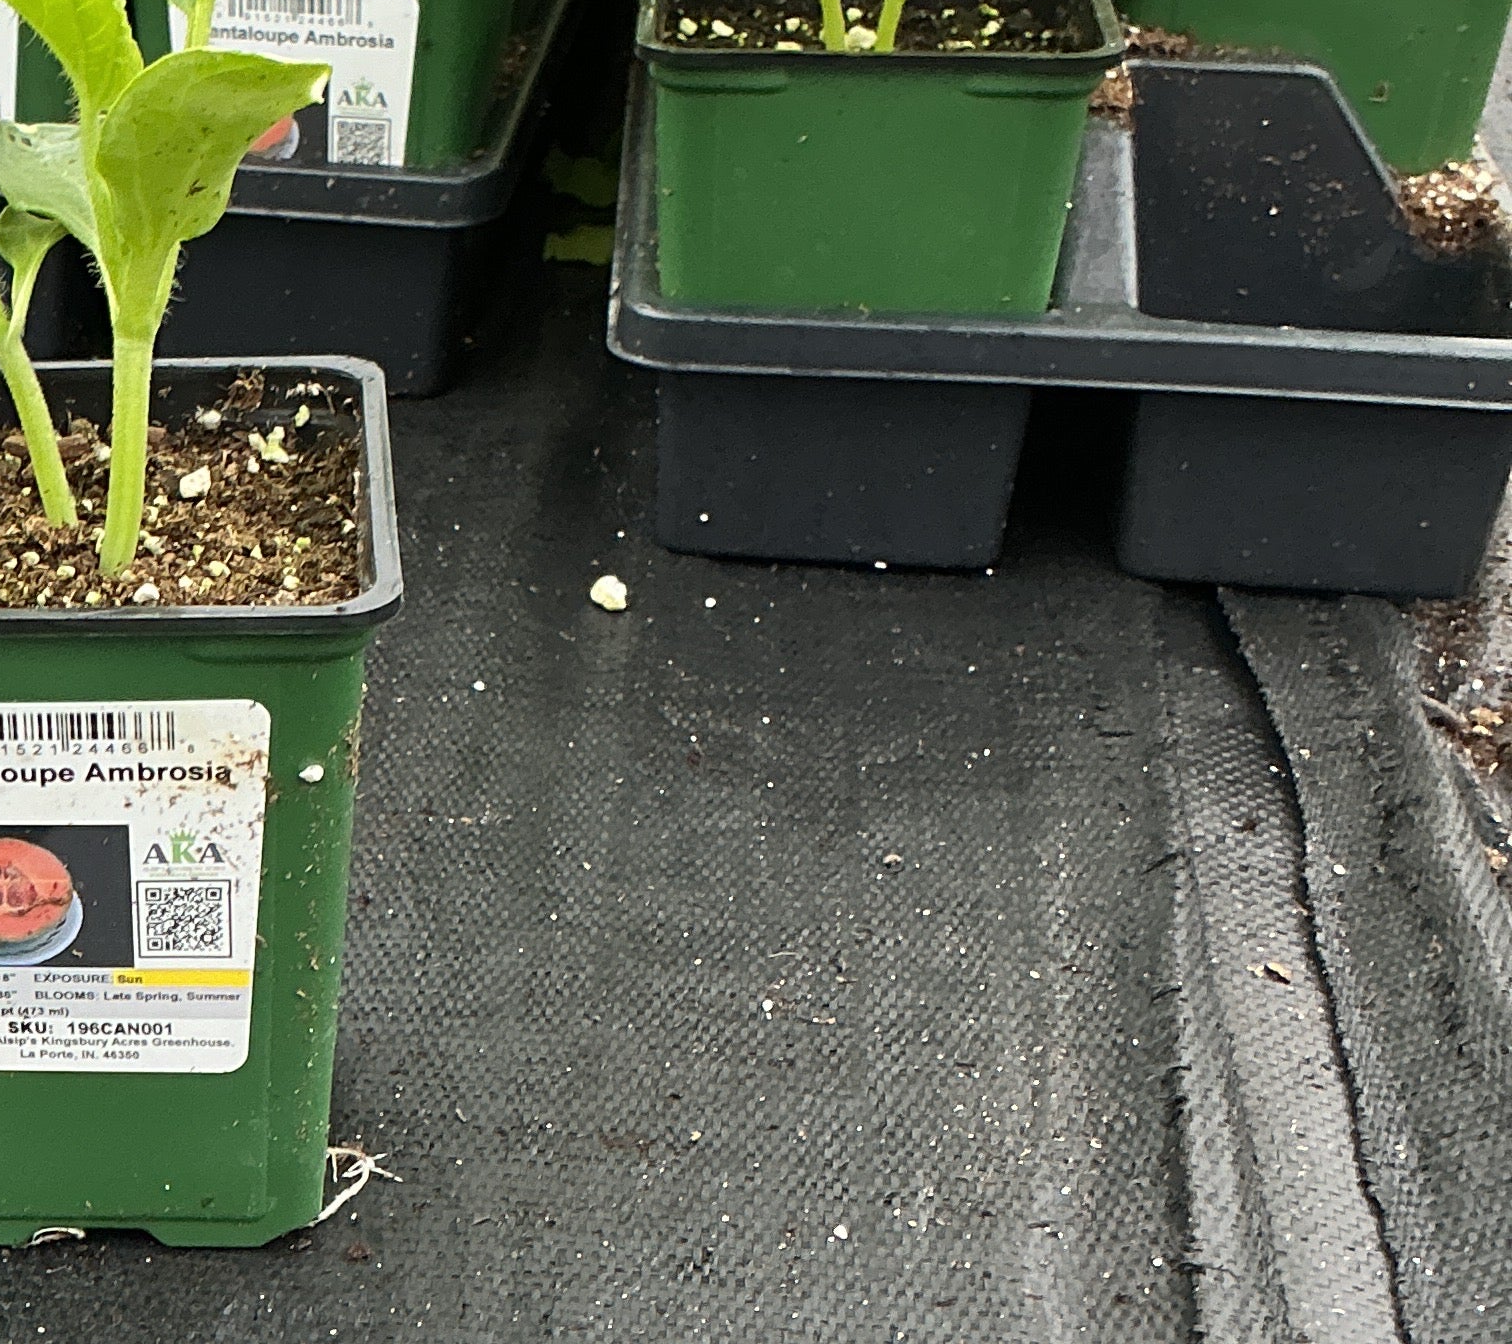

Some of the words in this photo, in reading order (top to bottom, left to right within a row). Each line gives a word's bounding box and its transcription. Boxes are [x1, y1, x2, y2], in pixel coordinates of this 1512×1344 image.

[210, 26, 299, 45] antaloupe
[304, 30, 395, 49] Ambrosia
[337, 89, 389, 107] AKA
[72, 742, 148, 755] 24466
[85, 760, 231, 784] Ambrosia
[142, 841, 225, 865] AKA
[34, 973, 113, 984] EXPOSURE:
[117, 974, 143, 985] Sun
[35, 990, 100, 1001] BLOOMS:
[103, 991, 132, 1001] Late
[136, 991, 182, 1003] Spring,
[187, 992, 241, 1002] Summer
[1, 1006, 14, 1016] pt
[49, 1006, 70, 1017] ml)
[8, 1020, 54, 1035] SKU:
[67, 1022, 173, 1035] 196CAN001
[41, 1036, 108, 1048] Kingsbury
[111, 1037, 148, 1047] Acres
[20, 1049, 36, 1059] La
[40, 1049, 78, 1061] Porte,
